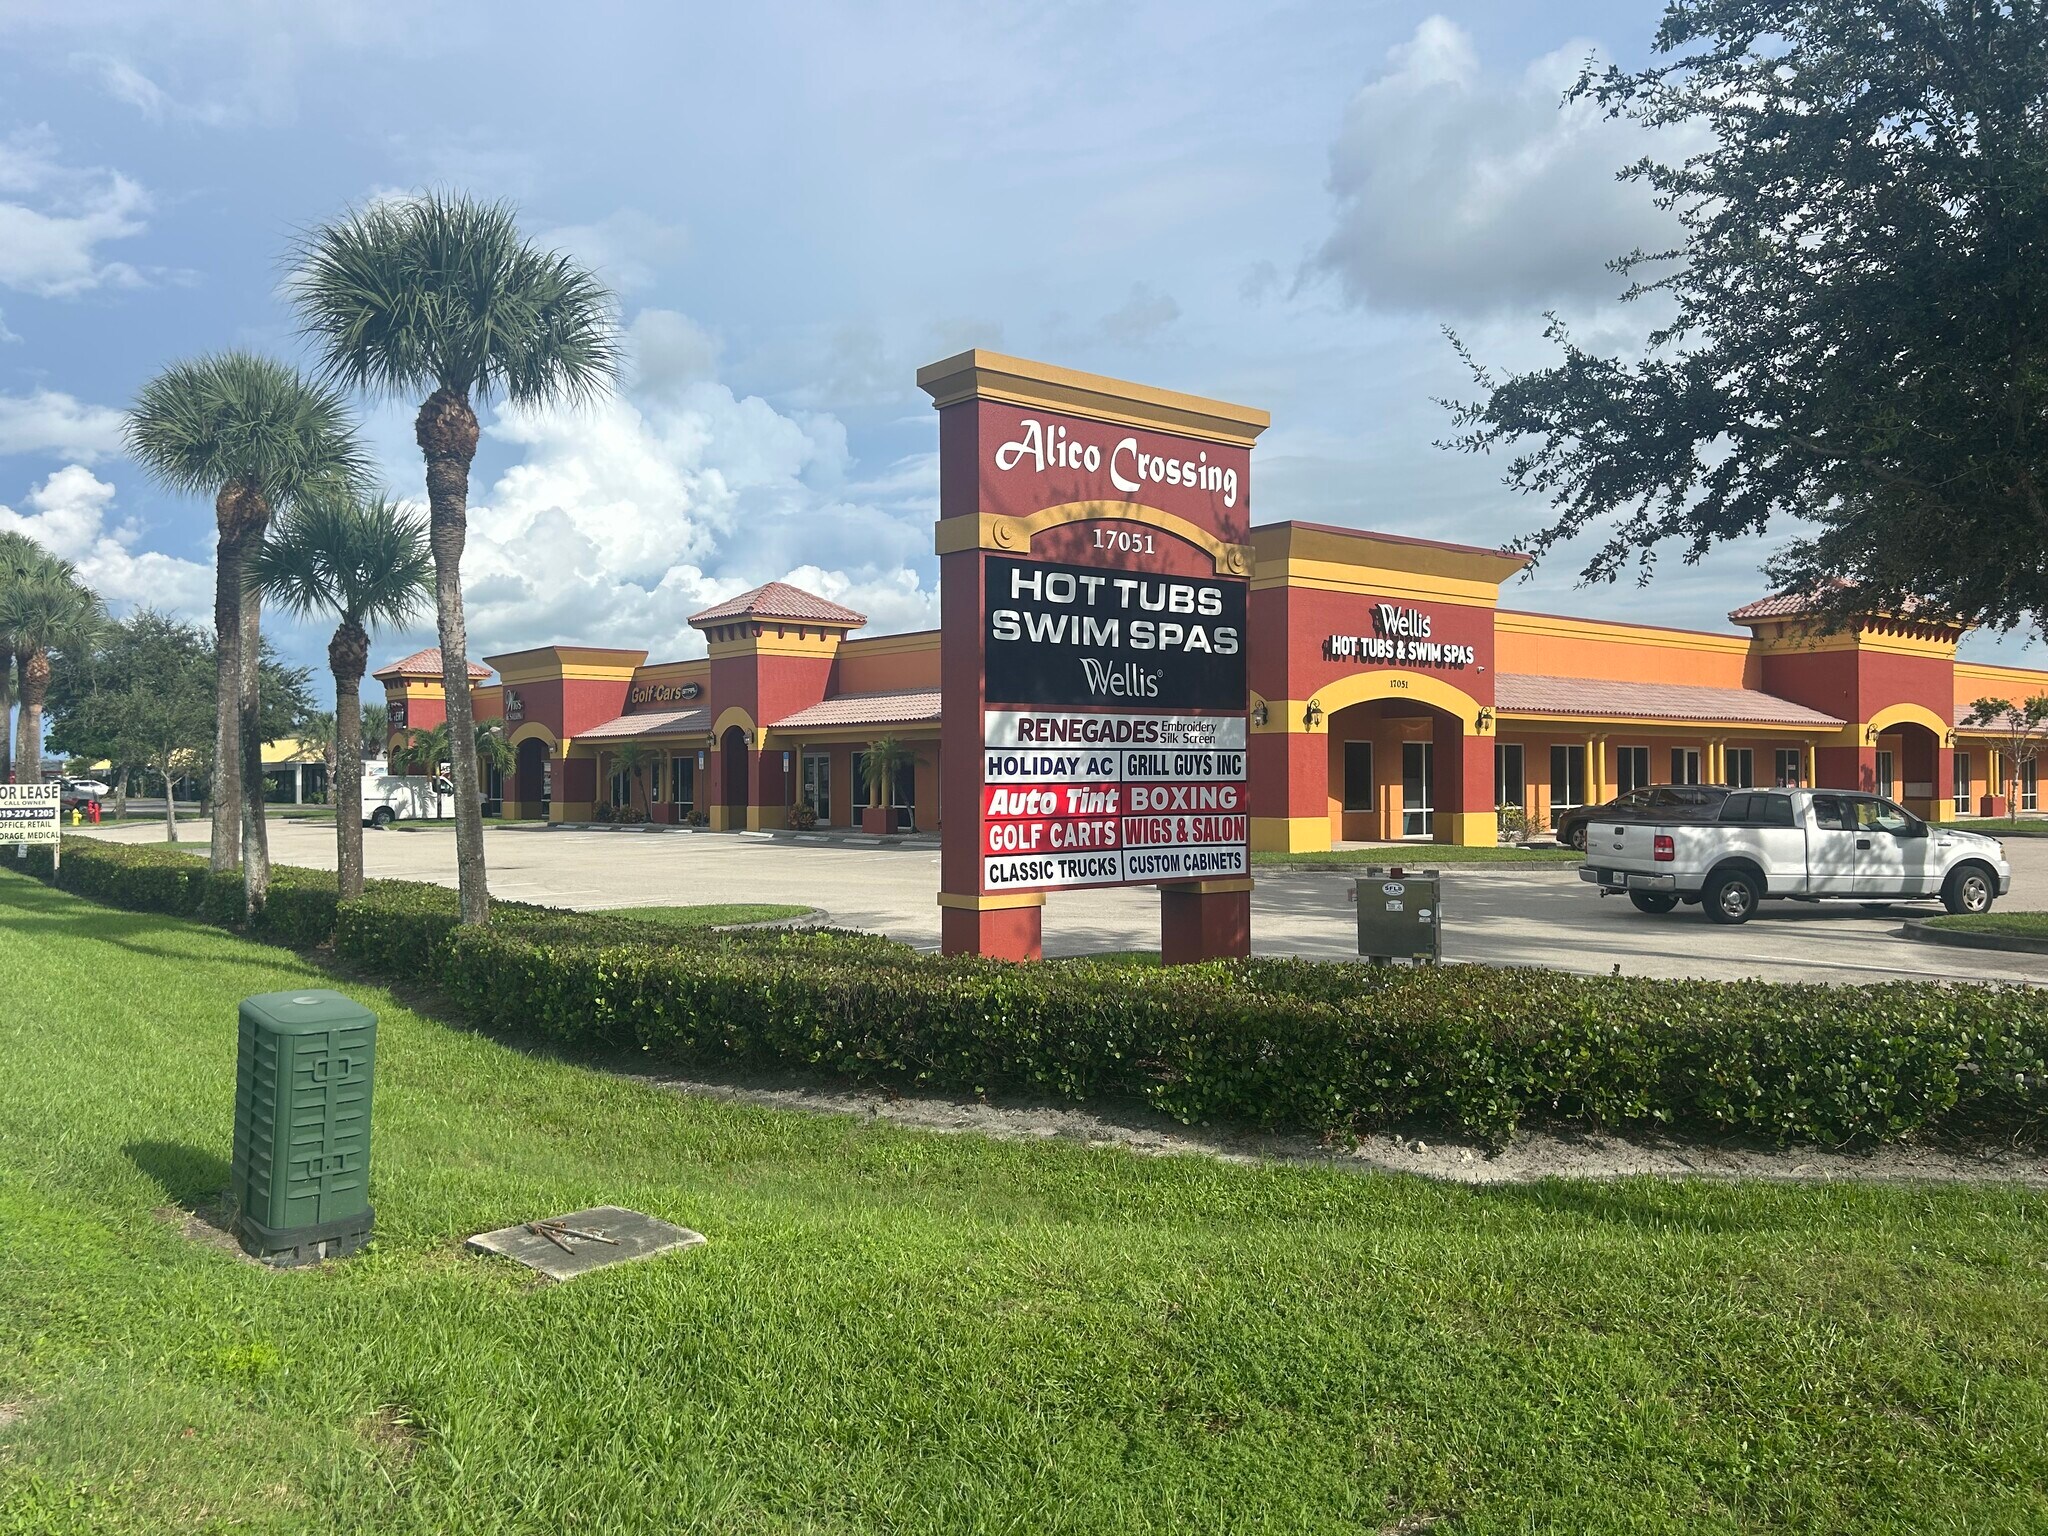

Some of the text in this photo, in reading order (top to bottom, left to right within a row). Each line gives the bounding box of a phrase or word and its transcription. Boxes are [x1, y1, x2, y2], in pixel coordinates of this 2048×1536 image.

[995, 419, 1238, 508] Alico Crossing
[1093, 528, 1155, 555] 17051
[1011, 568, 1223, 616] HOT TUBS
[992, 609, 1239, 655] SWIM SPAS
[1331, 635, 1474, 664] HOT TUBS & SWIM SPAS
[631, 684, 681, 704] Golf Cars
[1390, 680, 1409, 689] 17051
[1018, 718, 1159, 743] RENEGADES
[1160, 733, 1216, 744] Silk Screen
[1161, 720, 1217, 734] Embroidery
[988, 757, 1114, 776] HOLIDAY AC
[1127, 754, 1242, 776] GRILL GUYS INC
[20, 786, 58, 799] LEASE
[987, 786, 1119, 816] Auto Tint
[1131, 786, 1238, 811] BOXING
[989, 821, 1116, 851] GOLF CARTS
[1124, 816, 1245, 845] WIGS & SALON
[989, 857, 1117, 883] CLASSIC TRUCKS
[1129, 851, 1242, 874] CUSTOM CABINETS
